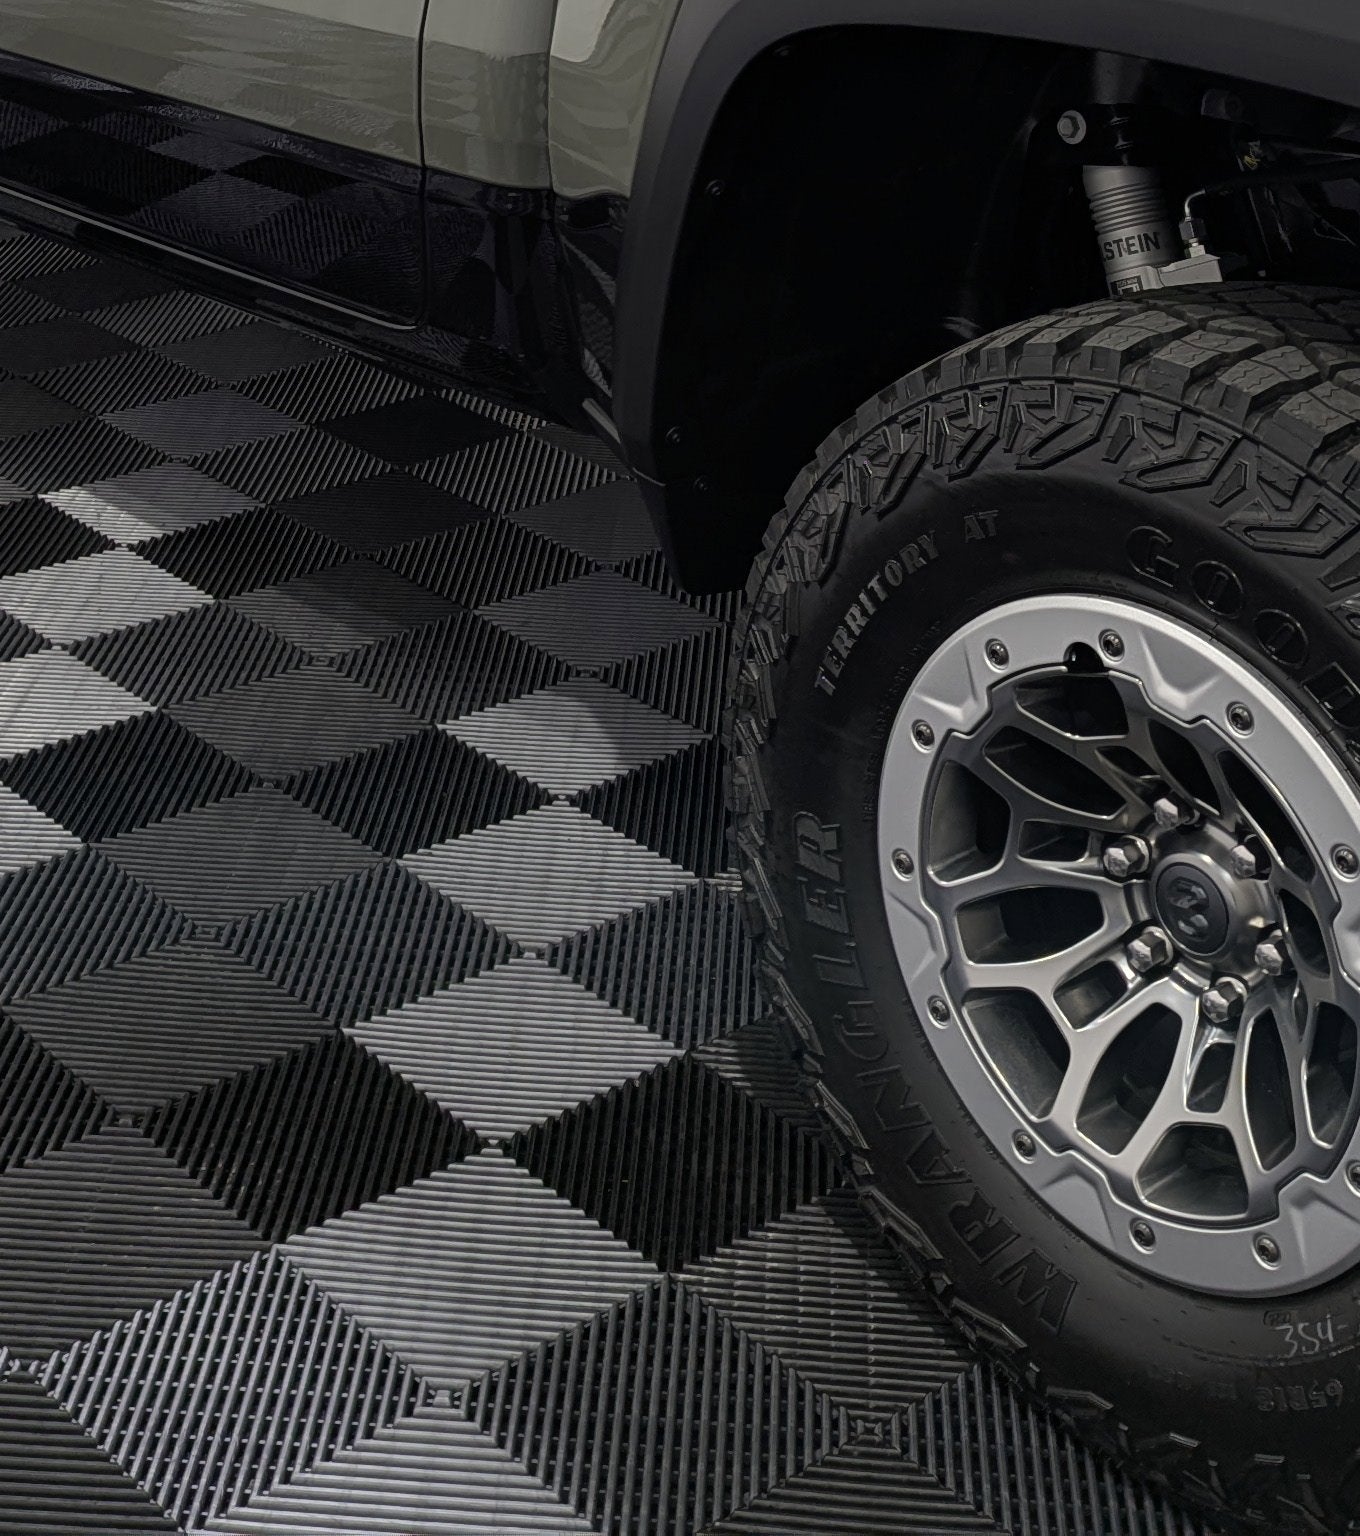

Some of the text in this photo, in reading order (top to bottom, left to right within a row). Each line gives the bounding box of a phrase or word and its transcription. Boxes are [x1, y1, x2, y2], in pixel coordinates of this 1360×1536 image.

[1102, 231, 1161, 261] STEIN
[813, 509, 1000, 697] TERRITORY AT
[793, 809, 1080, 1336] WRANGLER
